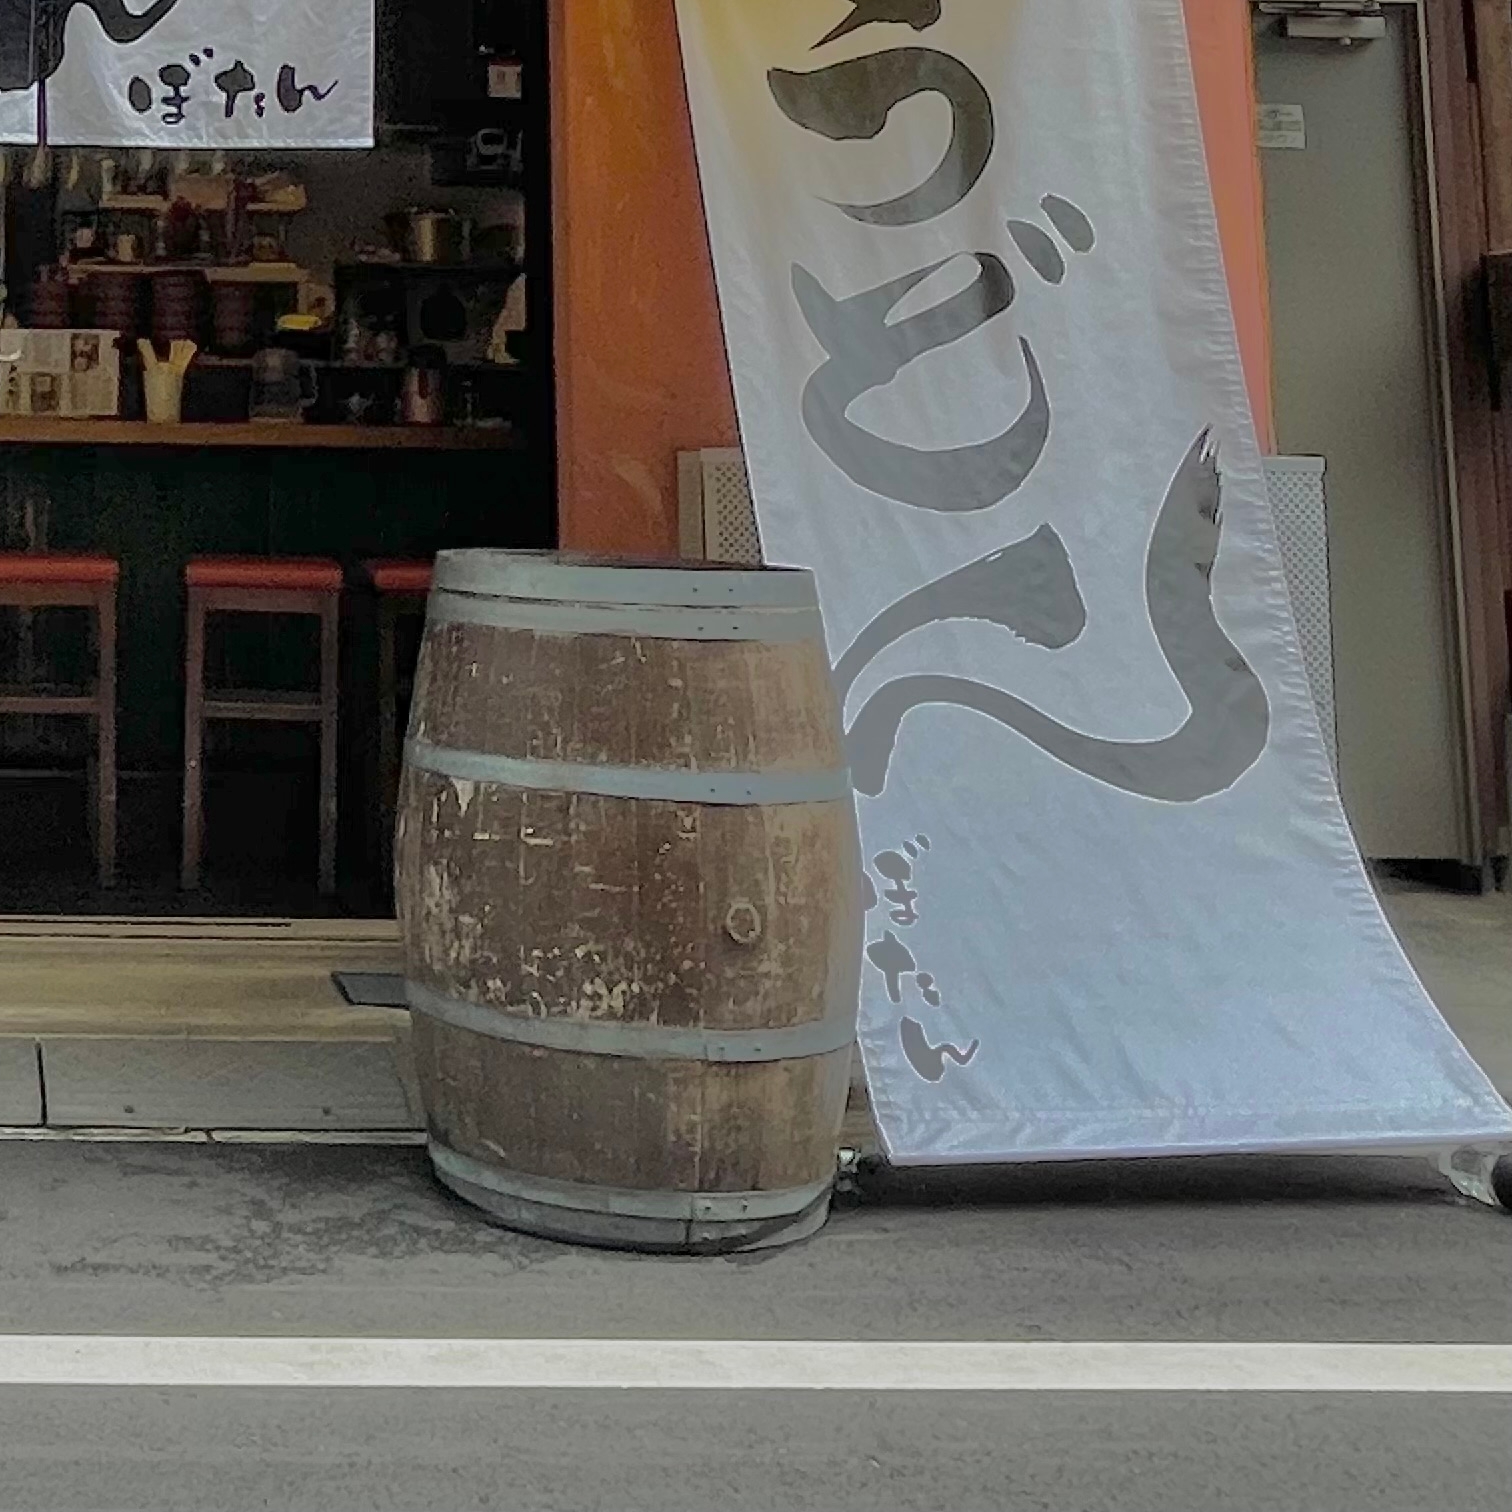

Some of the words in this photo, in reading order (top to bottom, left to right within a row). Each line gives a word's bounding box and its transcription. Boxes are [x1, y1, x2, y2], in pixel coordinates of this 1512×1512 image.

[128, 47, 339, 125] ぼたん
[863, 833, 980, 1083] ぼたん
